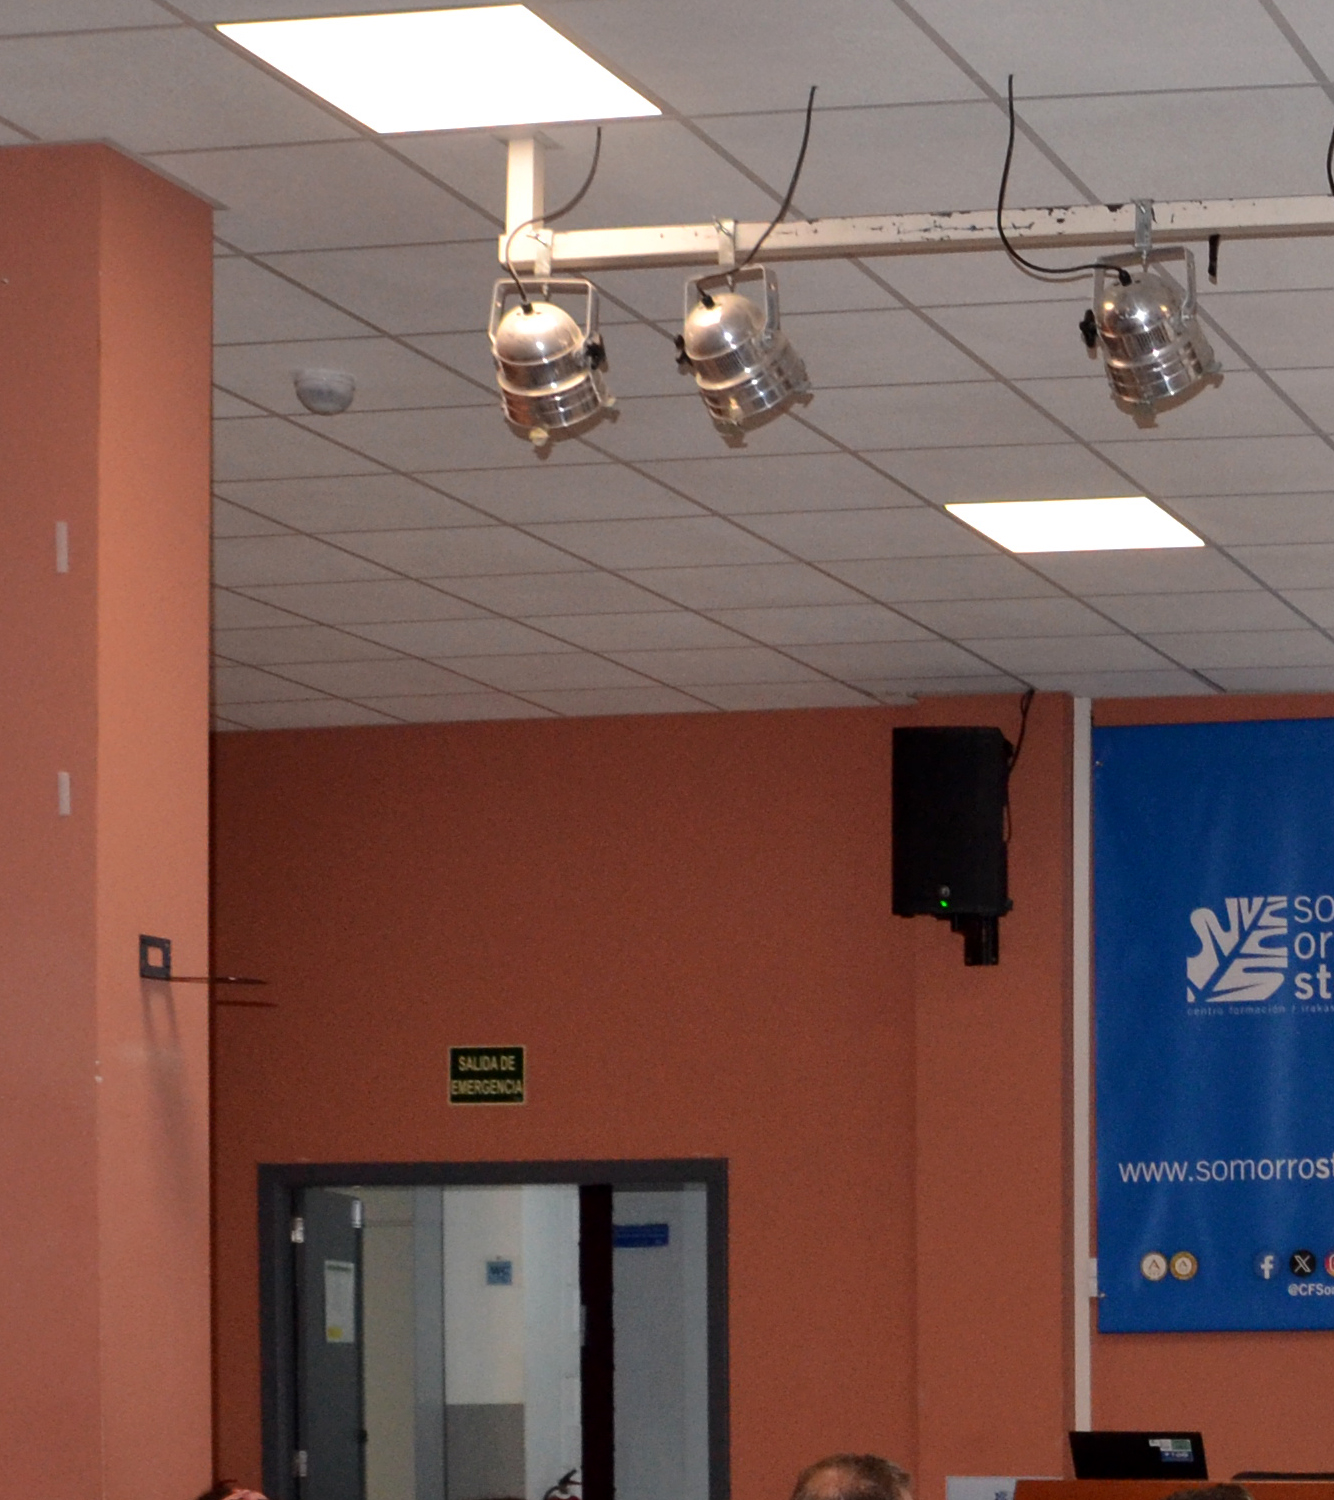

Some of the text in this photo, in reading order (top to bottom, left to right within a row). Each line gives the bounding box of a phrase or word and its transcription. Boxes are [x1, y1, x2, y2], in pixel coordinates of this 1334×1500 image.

[458, 1055, 516, 1071] SALIDA DE
[451, 1079, 523, 1095] EMERGENCIA
